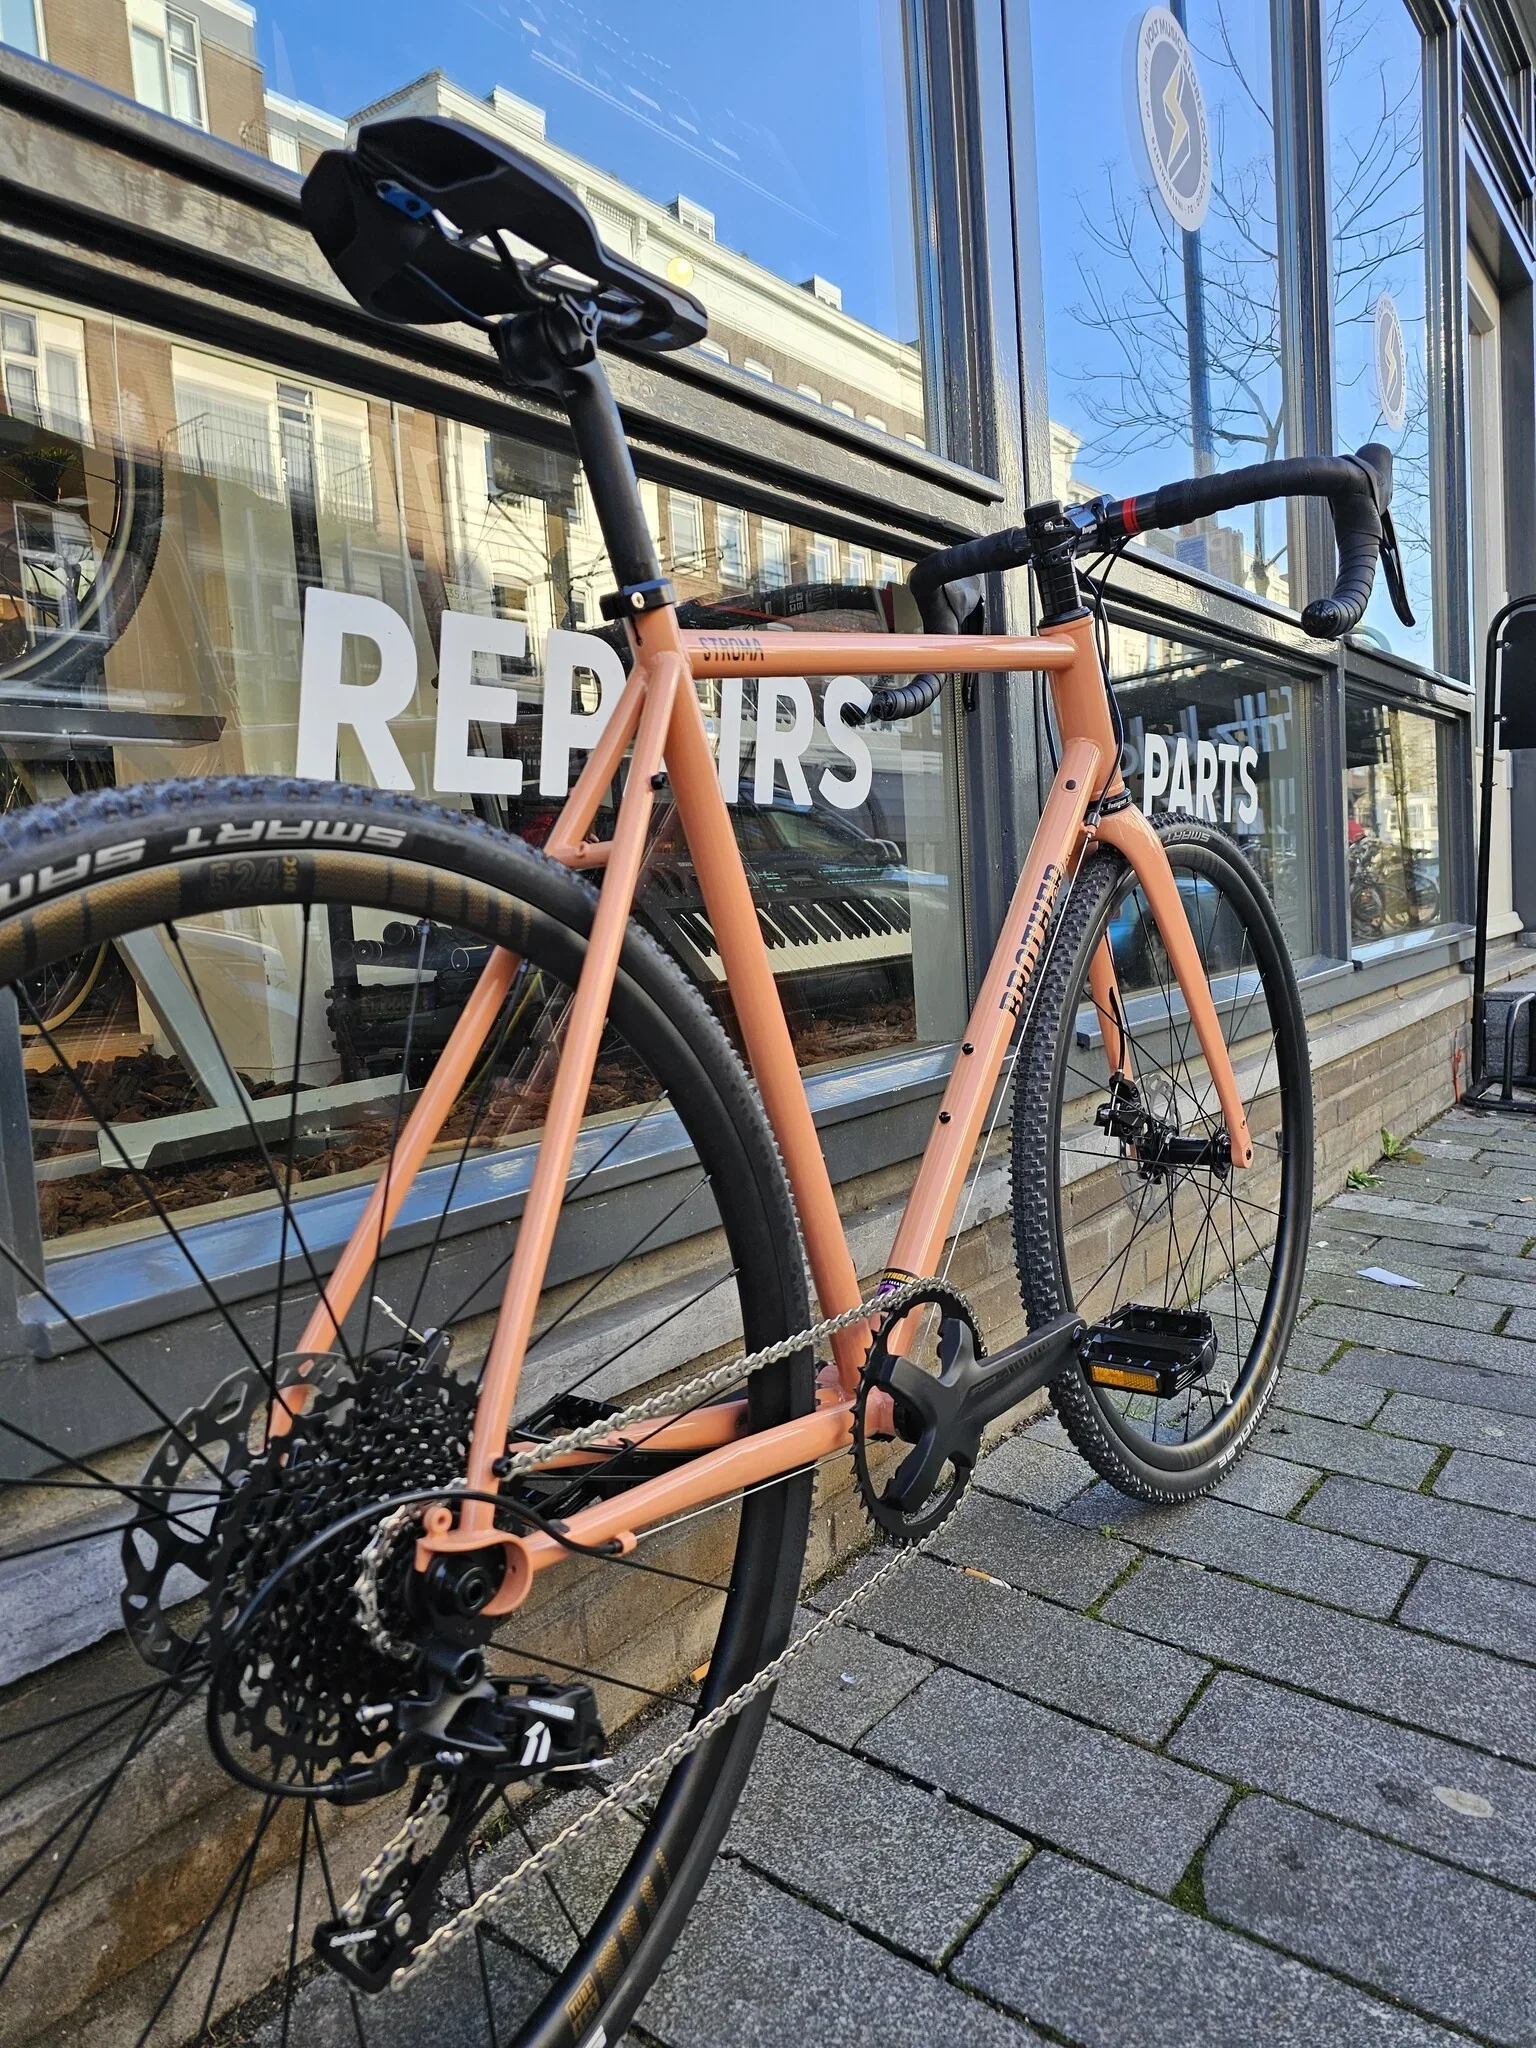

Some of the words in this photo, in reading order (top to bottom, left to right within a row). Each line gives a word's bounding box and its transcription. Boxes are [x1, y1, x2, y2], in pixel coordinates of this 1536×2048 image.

[699, 636, 765, 662] STROMA
[294, 586, 874, 810] REPIRS
[1143, 732, 1259, 825] PARTS
[170, 819, 408, 854] SMART
[1164, 830, 1211, 844] SMART
[999, 861, 1064, 1018] BROTHER
[1218, 1365, 1280, 1469] SCHWALBE
